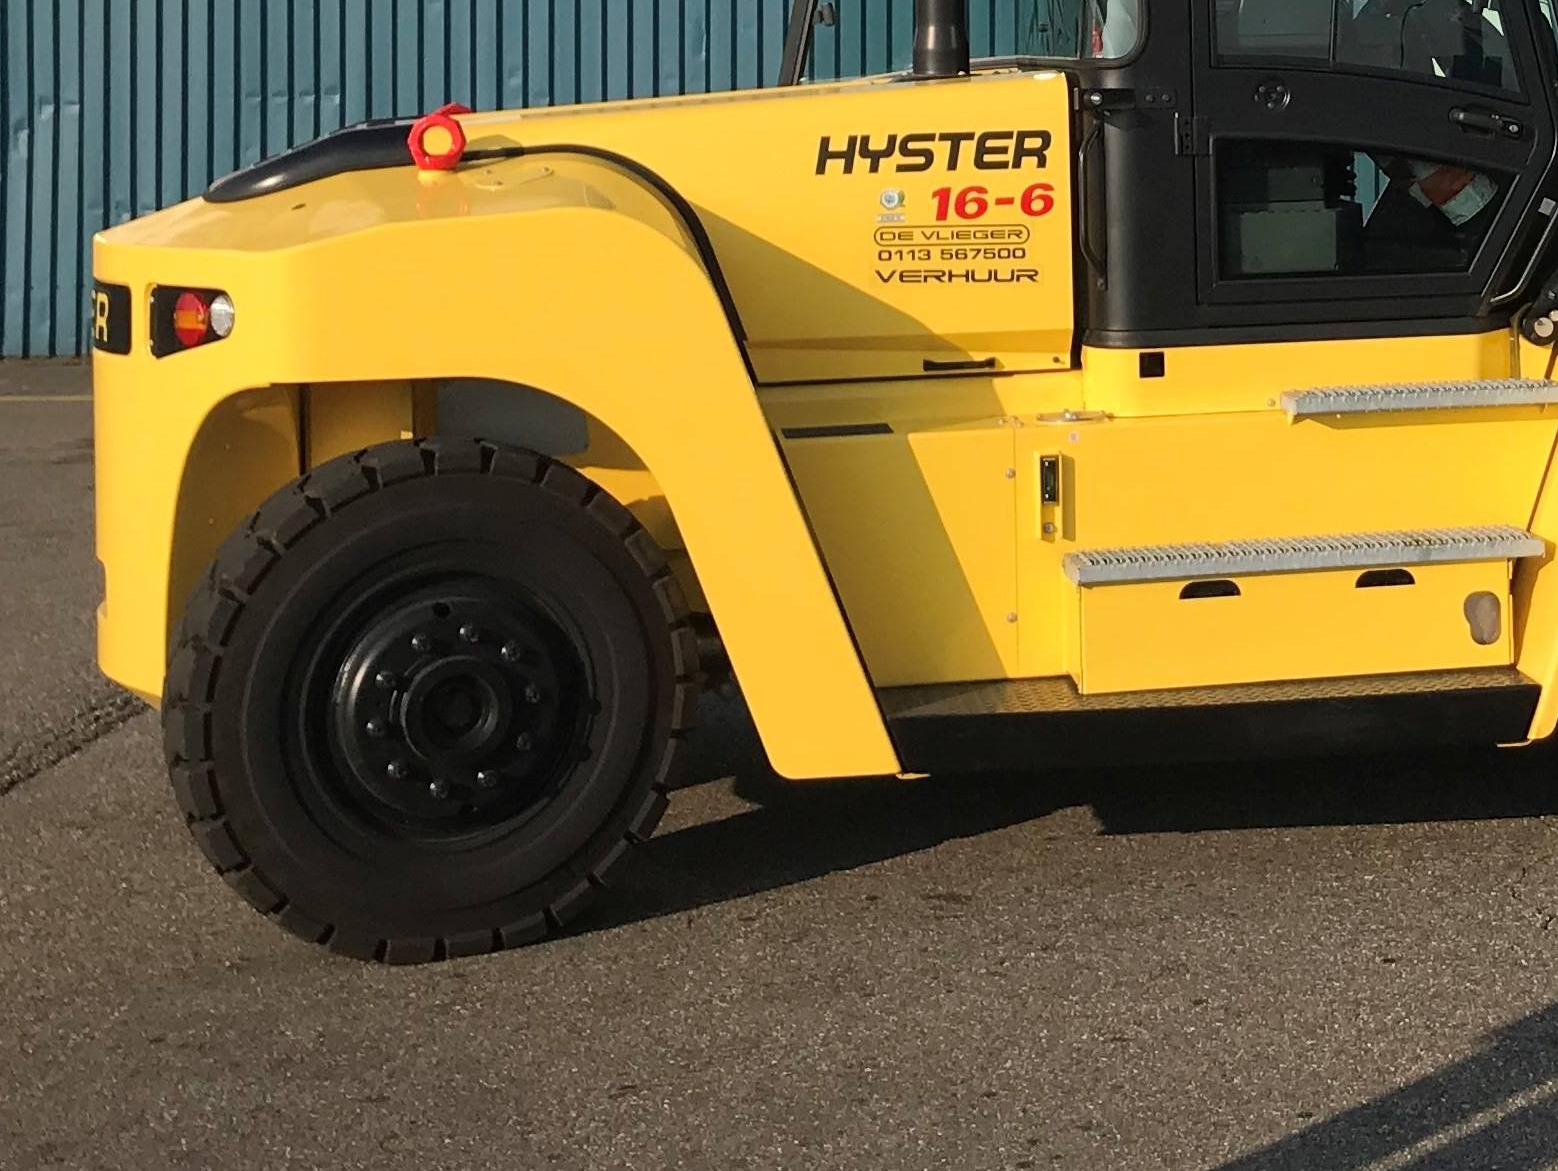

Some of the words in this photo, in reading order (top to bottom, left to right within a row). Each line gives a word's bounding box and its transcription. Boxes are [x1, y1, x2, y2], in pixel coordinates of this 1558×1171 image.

[815, 129, 1052, 174] HYSTER
[932, 182, 1055, 222] 16-6
[879, 230, 914, 241] DE
[921, 229, 1024, 241] VLIEGER
[878, 248, 931, 262] 0113
[940, 247, 1026, 261] 567500
[875, 268, 1039, 283] VERHUUR
